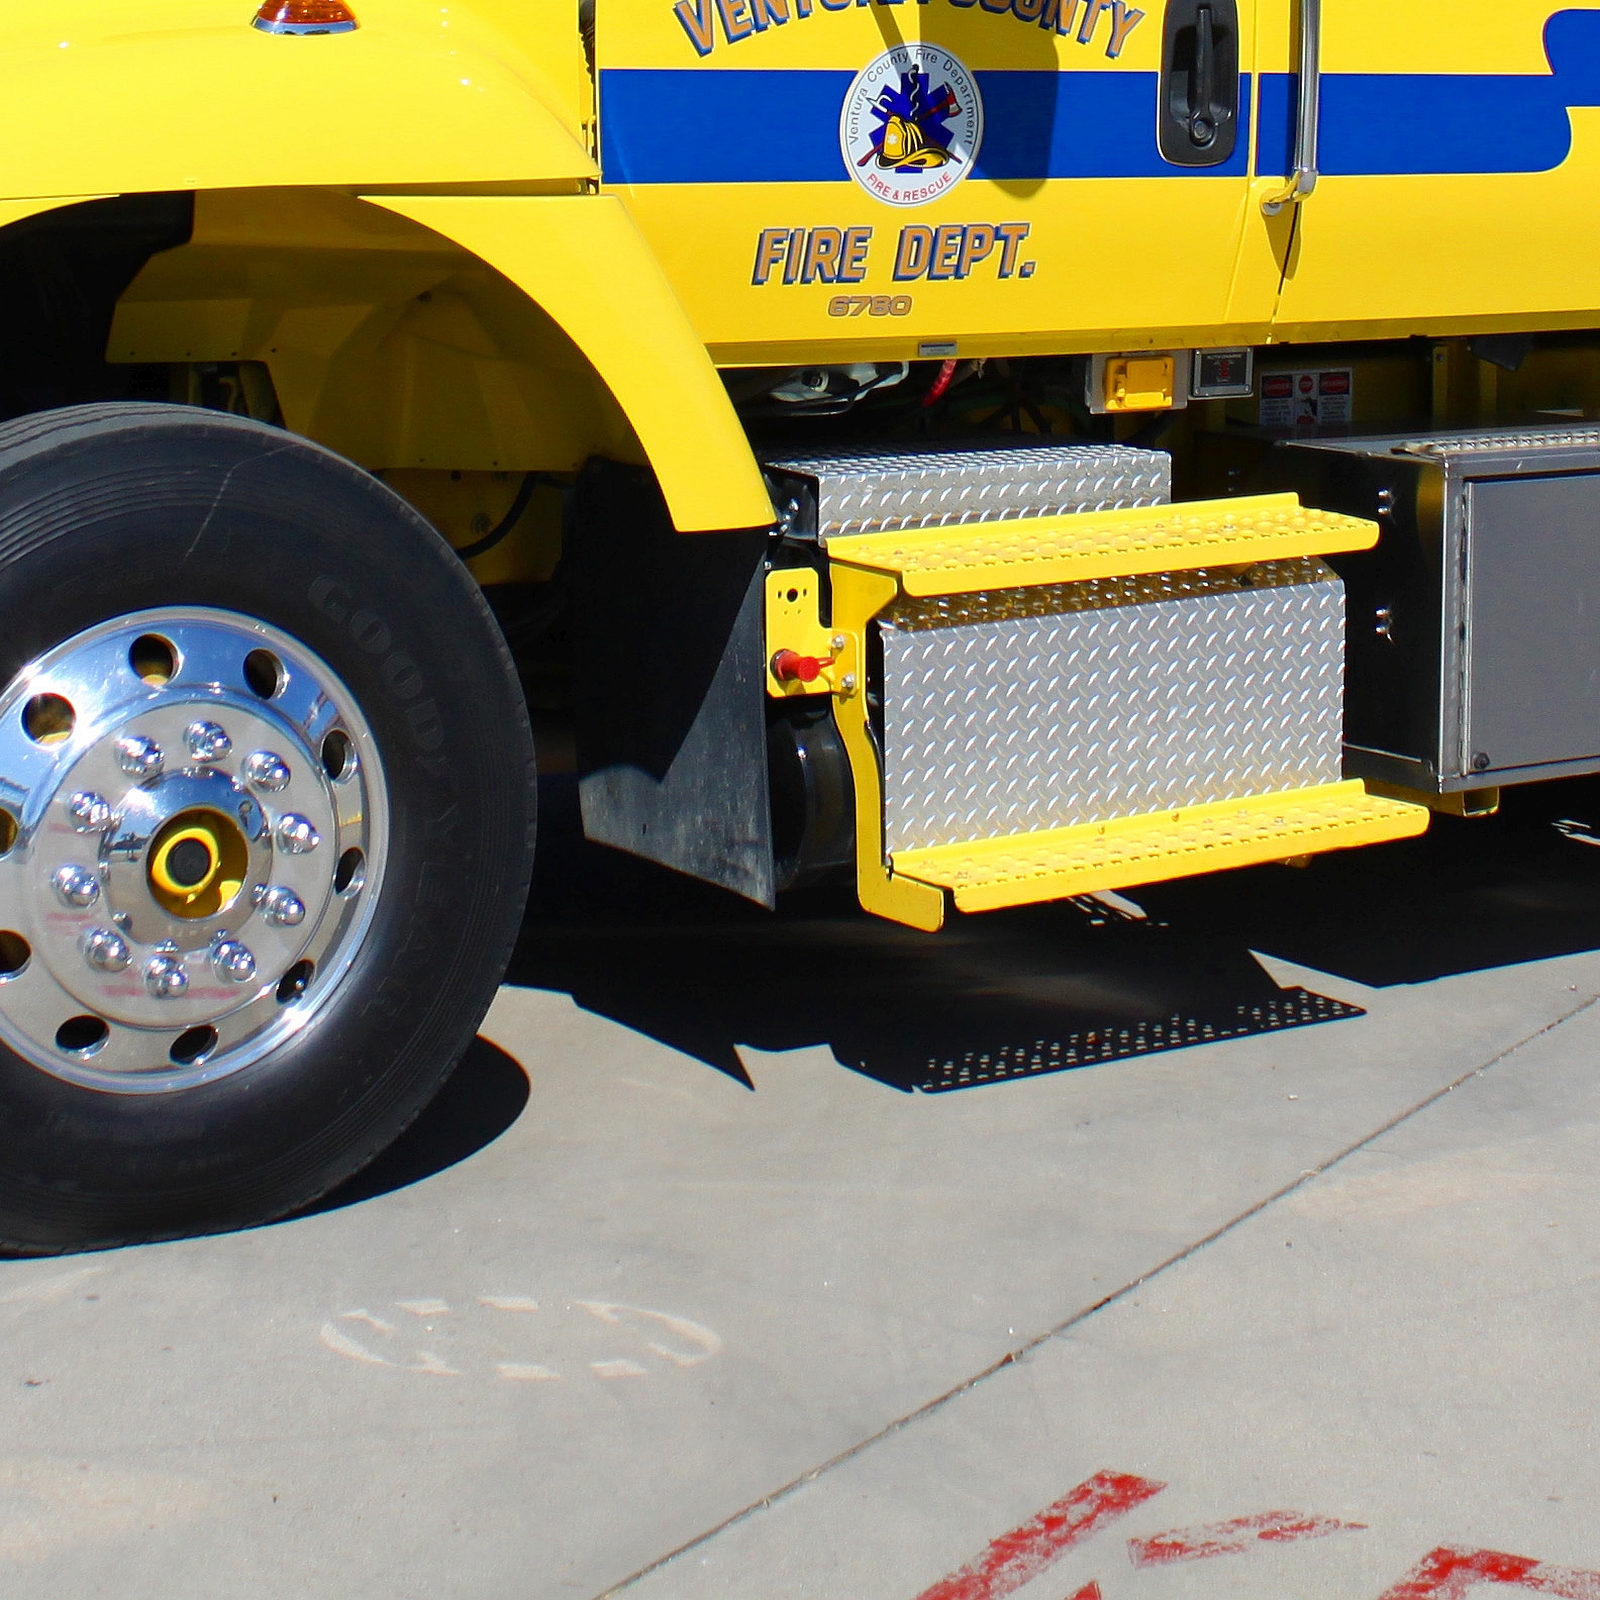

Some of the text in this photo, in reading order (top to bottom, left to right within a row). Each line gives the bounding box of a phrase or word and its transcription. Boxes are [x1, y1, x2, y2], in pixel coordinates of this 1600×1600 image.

[849, 48, 975, 145] Ventura County Fire Department
[866, 172, 952, 201] FIRE & RESCUE
[752, 222, 1037, 284] FIRE DEPT.
[827, 295, 912, 317] 6780
[309, 574, 461, 1018] GOODYEAR
